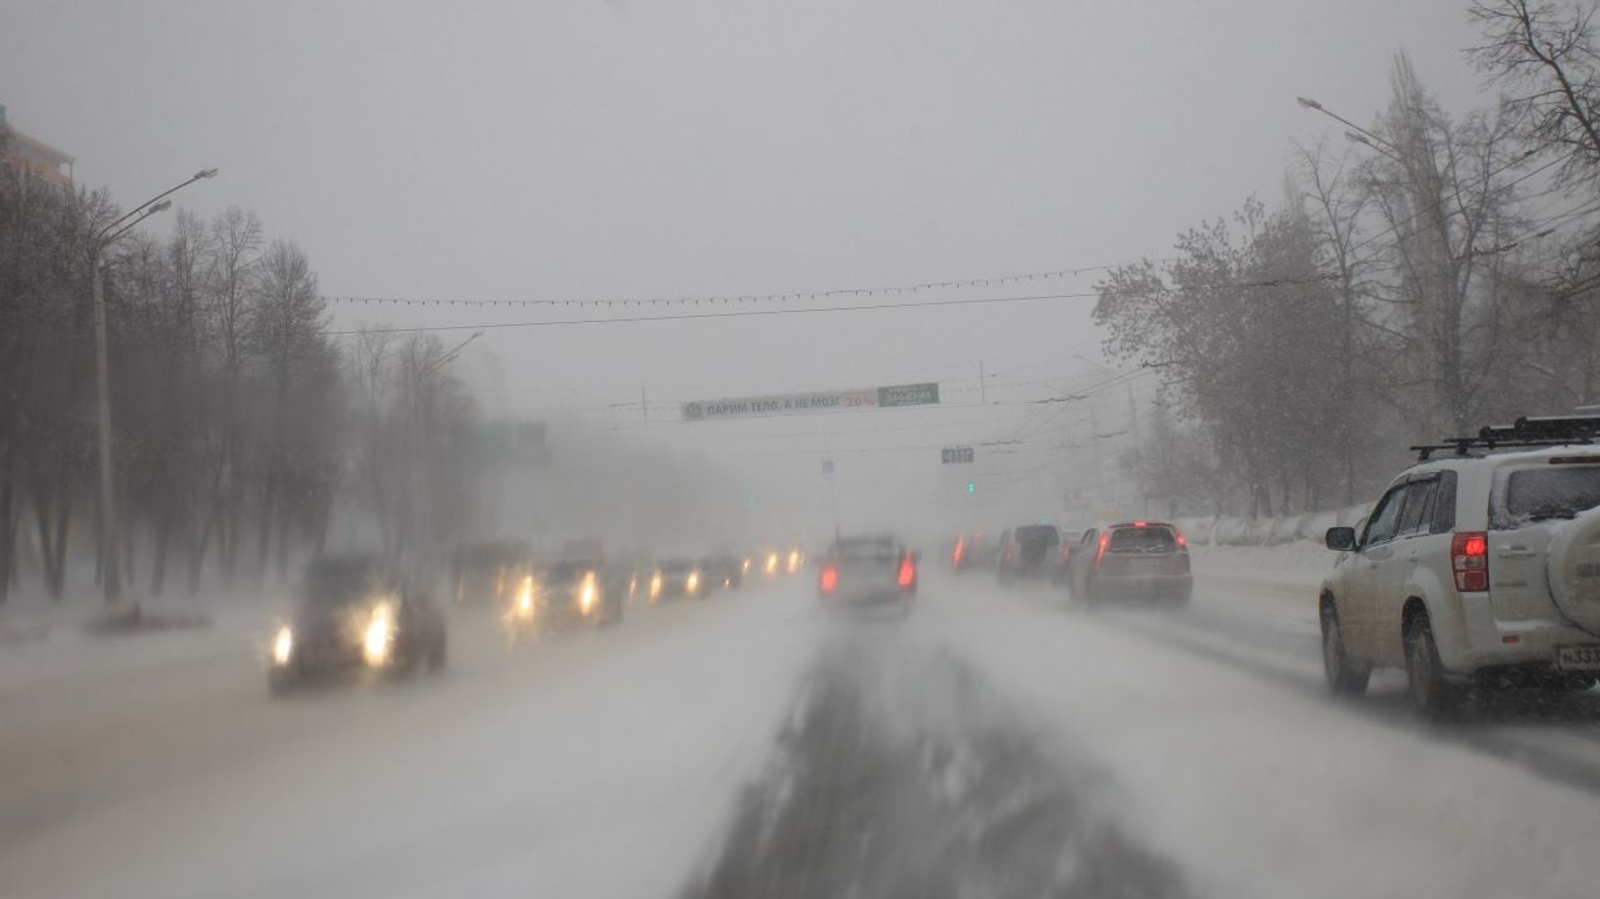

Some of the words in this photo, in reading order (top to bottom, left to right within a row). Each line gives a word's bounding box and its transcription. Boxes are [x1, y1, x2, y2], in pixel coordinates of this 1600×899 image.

[707, 403, 747, 416] ПАРИМ
[784, 399, 792, 409] А
[795, 398, 811, 408] НЕ
[811, 396, 840, 407] МОЗГ
